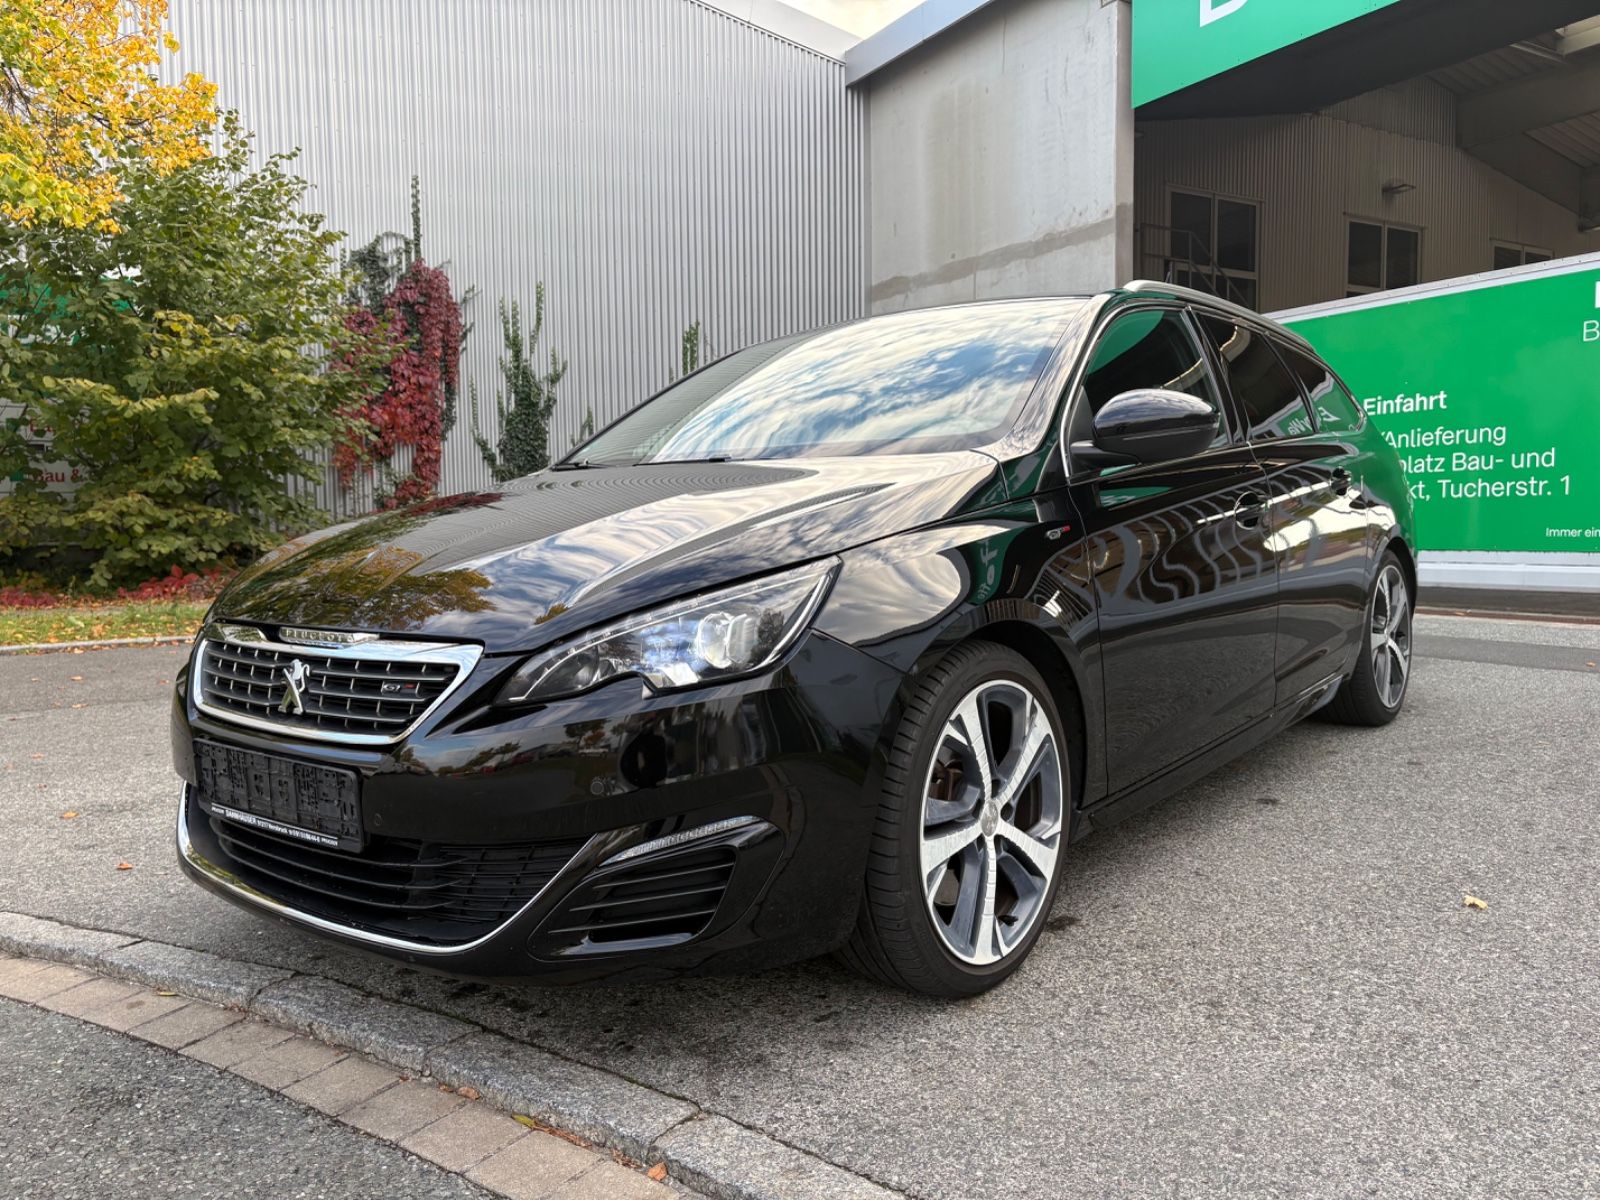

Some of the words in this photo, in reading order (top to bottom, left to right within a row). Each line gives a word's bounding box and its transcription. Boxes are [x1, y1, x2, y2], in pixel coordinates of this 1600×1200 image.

[1363, 390, 1447, 416] Einfahrt
[1381, 426, 1506, 449] Anlieferung
[1452, 452, 1504, 472] Bau-
[1511, 447, 1555, 469] und
[1437, 476, 1552, 499] Tucherstr.
[1560, 474, 1570, 496] 1
[1545, 527, 1582, 538] Immer
[285, 627, 344, 642] PEUGEOT
